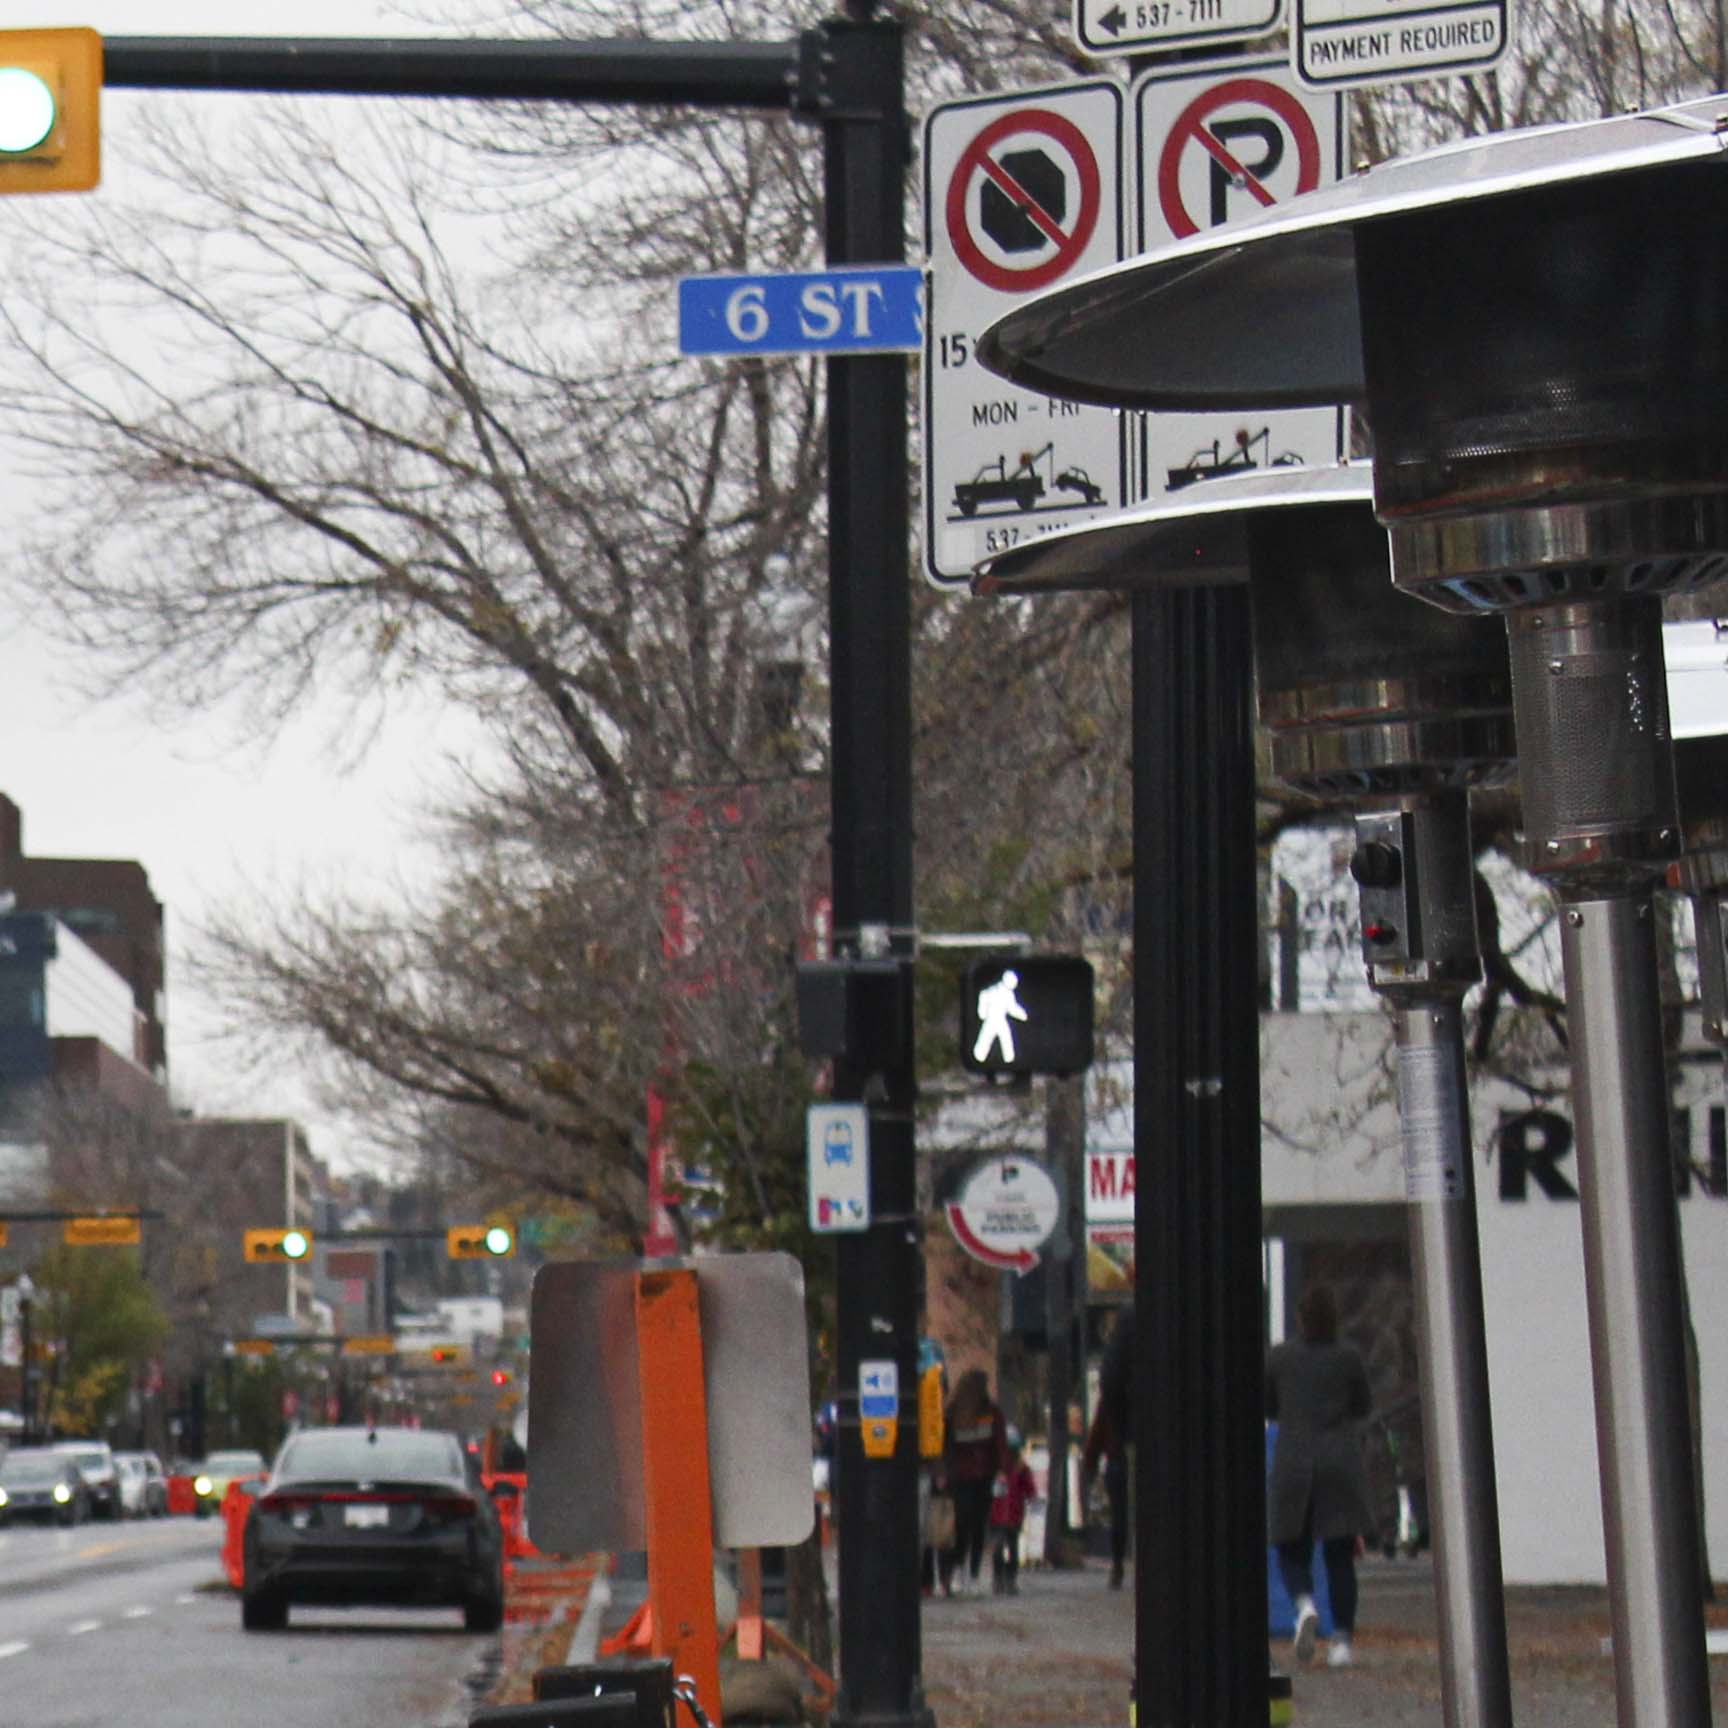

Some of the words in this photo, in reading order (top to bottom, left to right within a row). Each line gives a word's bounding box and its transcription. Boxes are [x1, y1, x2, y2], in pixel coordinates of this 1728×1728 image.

[1310, 32, 1393, 65] PAYMENT
[1400, 20, 1495, 54] REQUIRED
[725, 286, 770, 342] 6
[799, 282, 884, 341] ST
[972, 401, 1018, 427] MON
